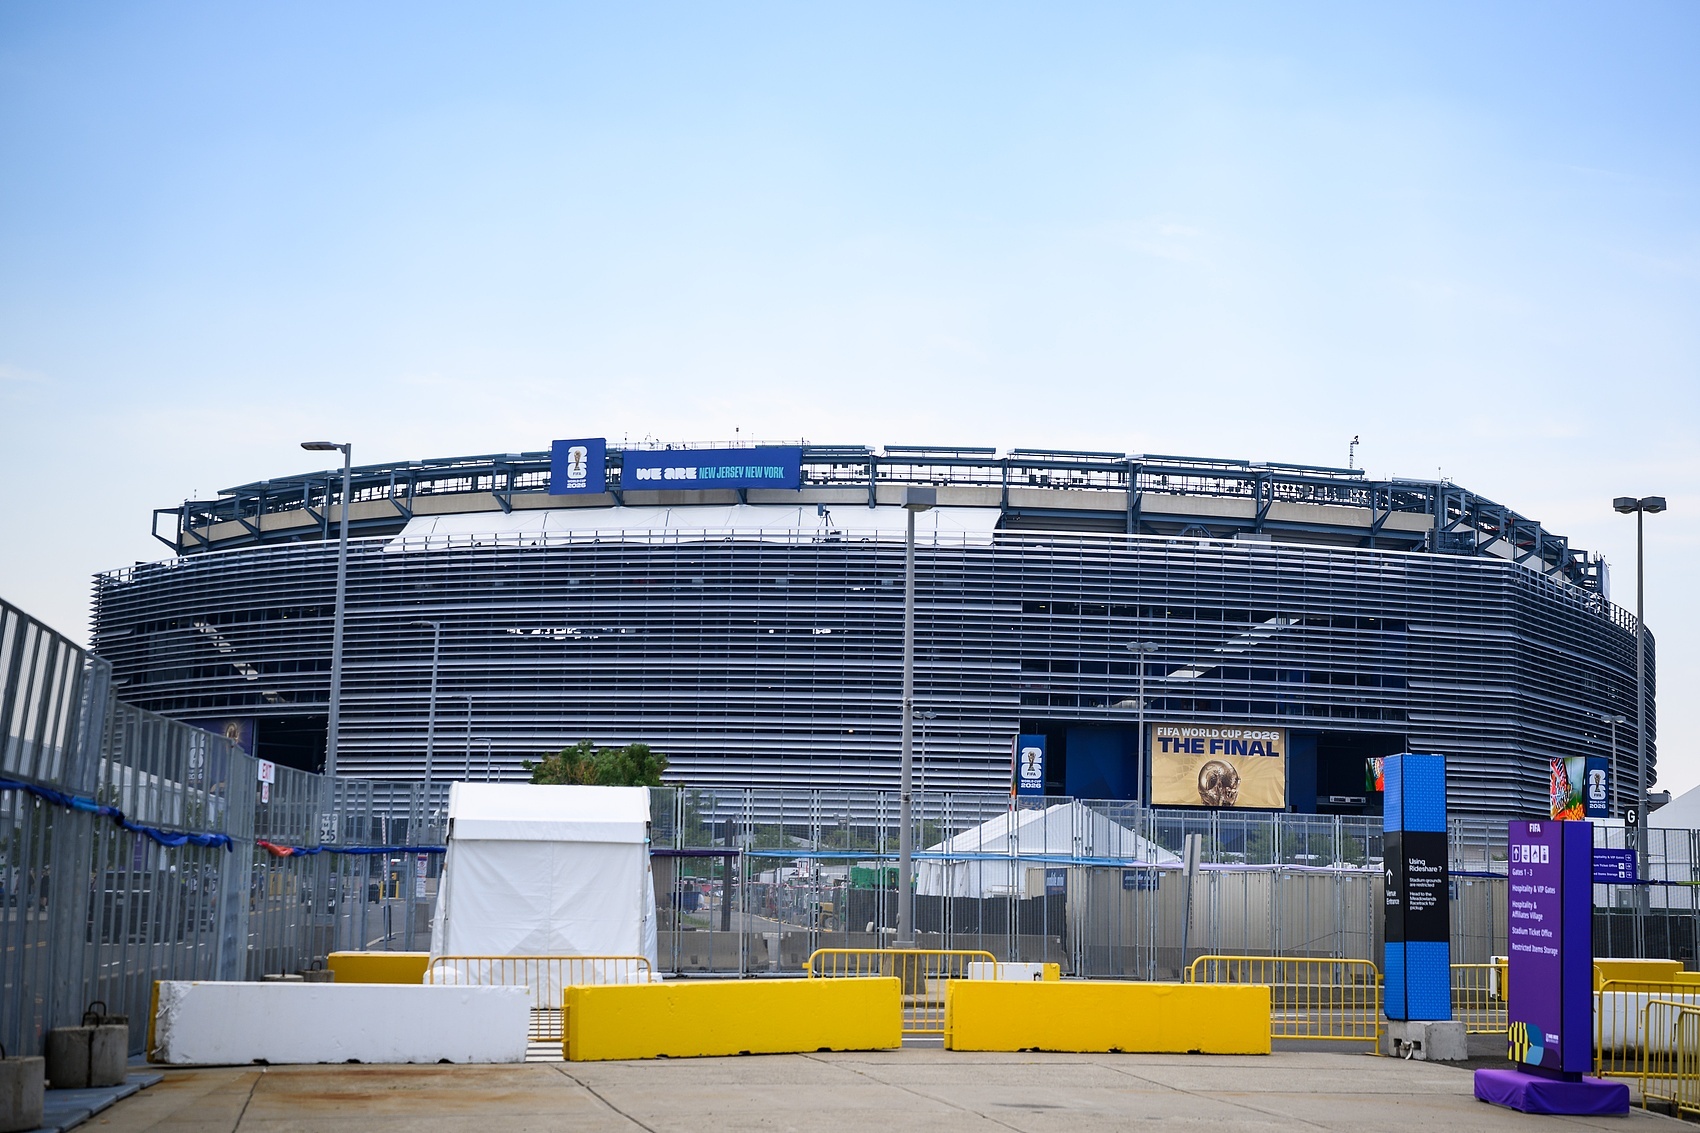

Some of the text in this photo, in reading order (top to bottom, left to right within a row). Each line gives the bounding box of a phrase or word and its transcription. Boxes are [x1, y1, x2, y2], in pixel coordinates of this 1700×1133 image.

[636, 468, 662, 480] WE
[664, 467, 697, 480] ARE
[699, 467, 716, 479] NEW
[716, 466, 744, 478] JERSEY
[745, 466, 762, 478] NEW
[1158, 727, 1280, 740] FIFA WORLD CUP 2026
[1158, 737, 1280, 757] THE FINAL
[1628, 810, 1635, 823] G
[1530, 823, 1541, 832] FIFA
[1409, 858, 1425, 866] Using
[1512, 884, 1532, 894] Hospitality
[1545, 886, 1556, 894] Gates
[1512, 900, 1532, 910] Hospitality
[1530, 912, 1543, 922] Village
[1512, 926, 1552, 937] Stadium Ticket Office
[1512, 942, 1531, 952] Restricted
[1544, 946, 1558, 956] Storage
